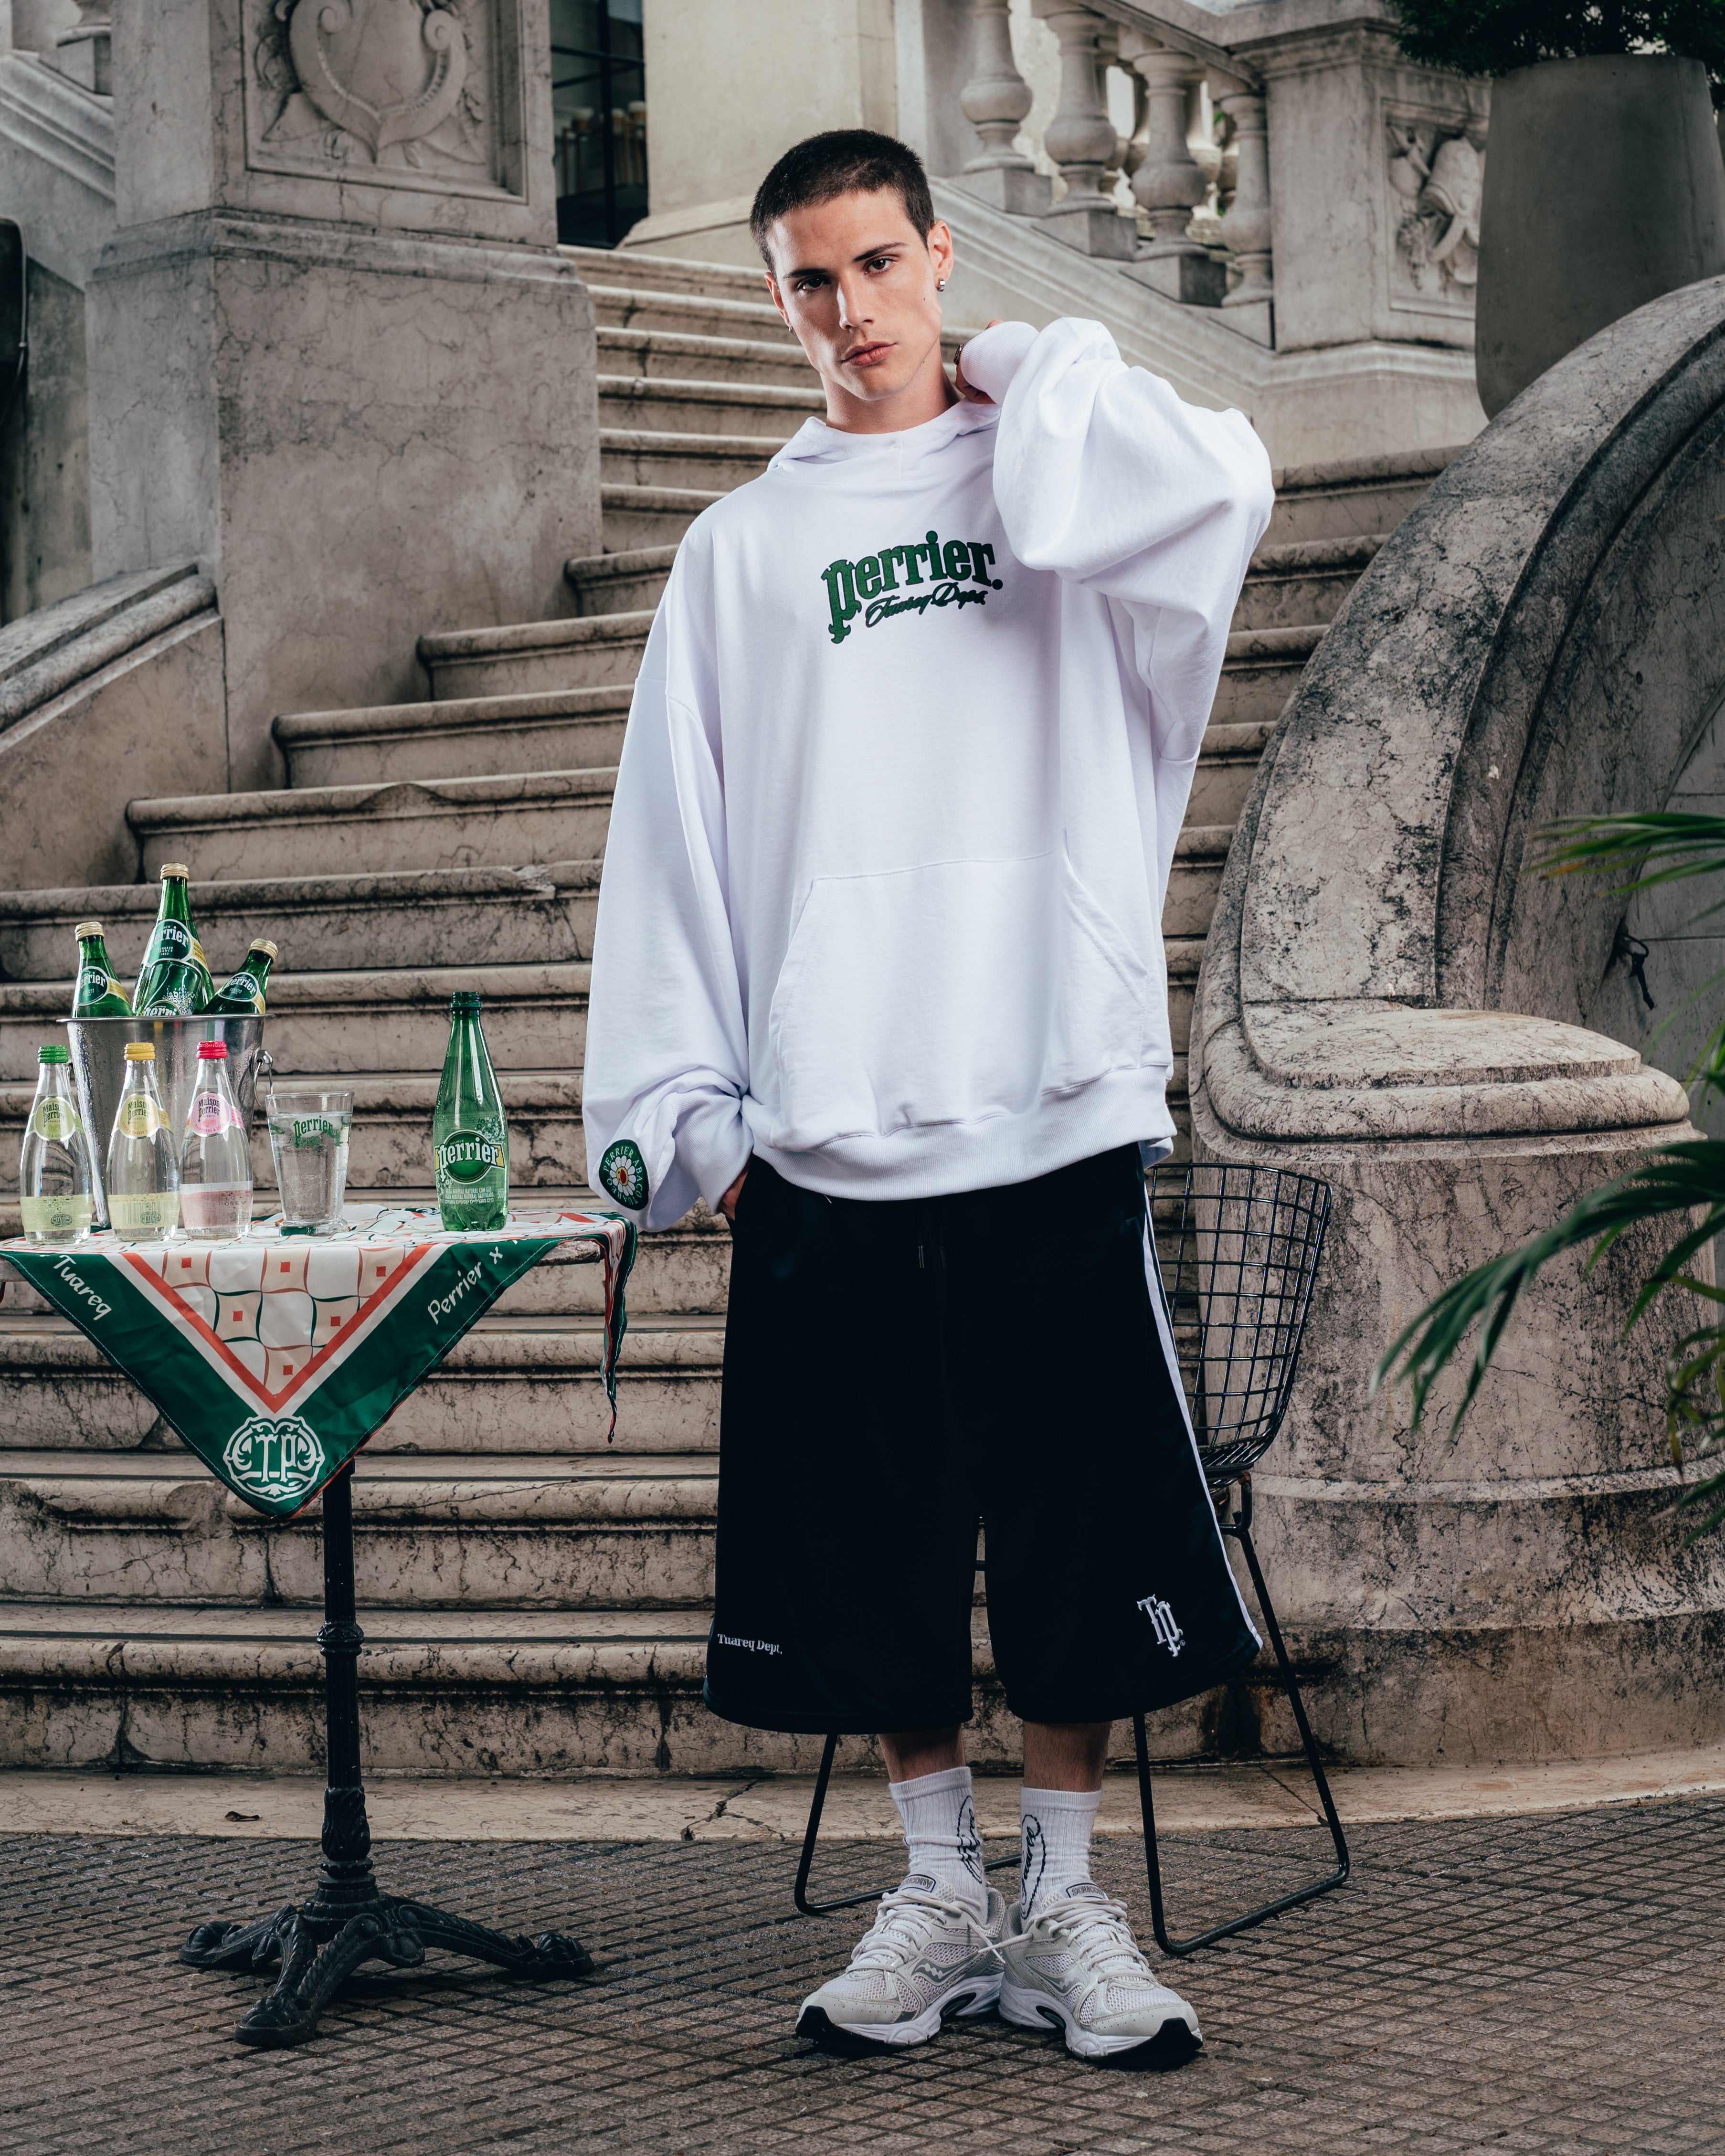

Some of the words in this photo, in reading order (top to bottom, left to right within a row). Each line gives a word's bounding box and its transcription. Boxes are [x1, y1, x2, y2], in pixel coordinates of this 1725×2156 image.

[153, 926, 189, 947] errier
[80, 972, 106, 989] errier
[199, 1097, 220, 1108] Maison
[603, 1146, 634, 1172] PERRIER
[633, 1159, 643, 1198] ABACO
[428, 1261, 482, 1325] Perrier
[717, 1633, 755, 1652] Tuareq
[756, 1639, 782, 1655] Dept.
